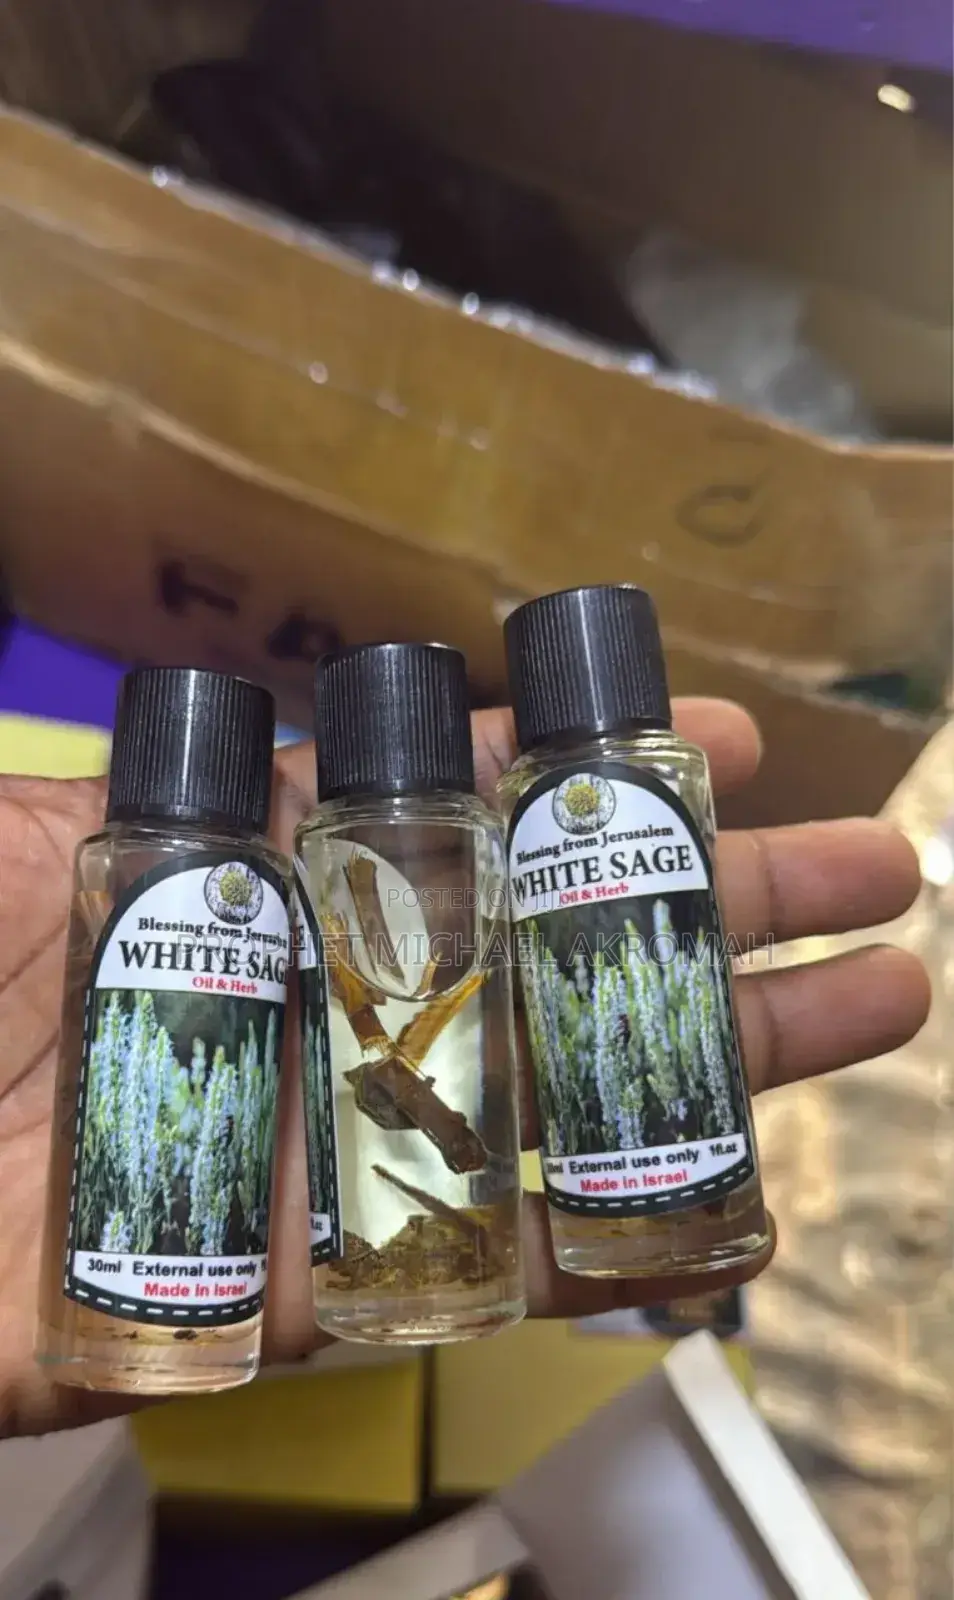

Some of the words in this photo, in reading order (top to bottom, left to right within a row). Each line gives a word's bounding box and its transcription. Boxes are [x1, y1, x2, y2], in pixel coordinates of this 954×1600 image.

[516, 843, 561, 866] Blessing
[563, 834, 599, 852] from
[601, 824, 674, 847] Jerusalem
[512, 855, 604, 900] WHITE
[609, 845, 693, 880] SAGE
[560, 889, 578, 904] Oil
[581, 888, 593, 901] &
[595, 882, 629, 898] Herb
[138, 917, 204, 938] Blessing
[208, 921, 243, 938] from
[118, 940, 241, 976] WHITE
[246, 950, 287, 985] SAG
[192, 976, 213, 990] Oil
[216, 979, 227, 991] &
[230, 979, 258, 994] Herb
[568, 1156, 627, 1175] External
[632, 1155, 661, 1168] use
[666, 1147, 700, 1165] only
[580, 1175, 619, 1193] Made
[623, 1174, 638, 1189] in
[643, 1169, 688, 1187] Israel
[87, 1258, 121, 1274] 30ml
[132, 1260, 204, 1277] External
[208, 1263, 233, 1277] use
[236, 1260, 257, 1278] only
[144, 1281, 190, 1298] Made
[195, 1281, 210, 1297] in
[214, 1281, 247, 1297] Israel
